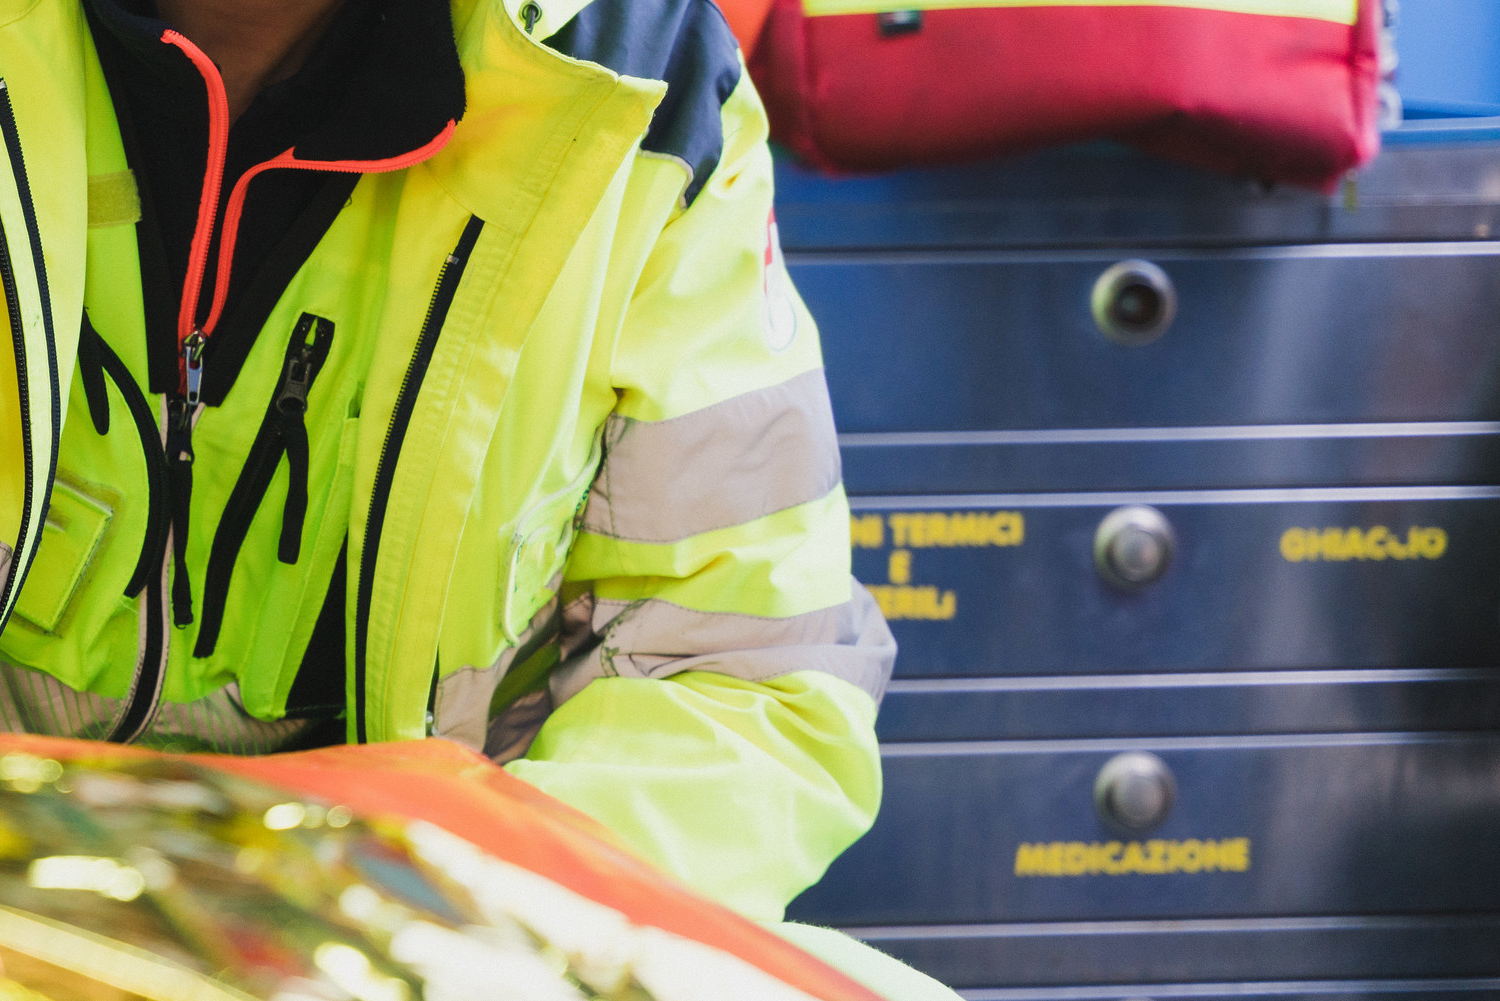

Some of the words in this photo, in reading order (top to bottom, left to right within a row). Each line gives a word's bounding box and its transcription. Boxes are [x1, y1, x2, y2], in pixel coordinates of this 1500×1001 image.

[887, 511, 1024, 547] TERMICI
[887, 549, 912, 585] E
[1014, 837, 1250, 876] MEDICAZIONE
